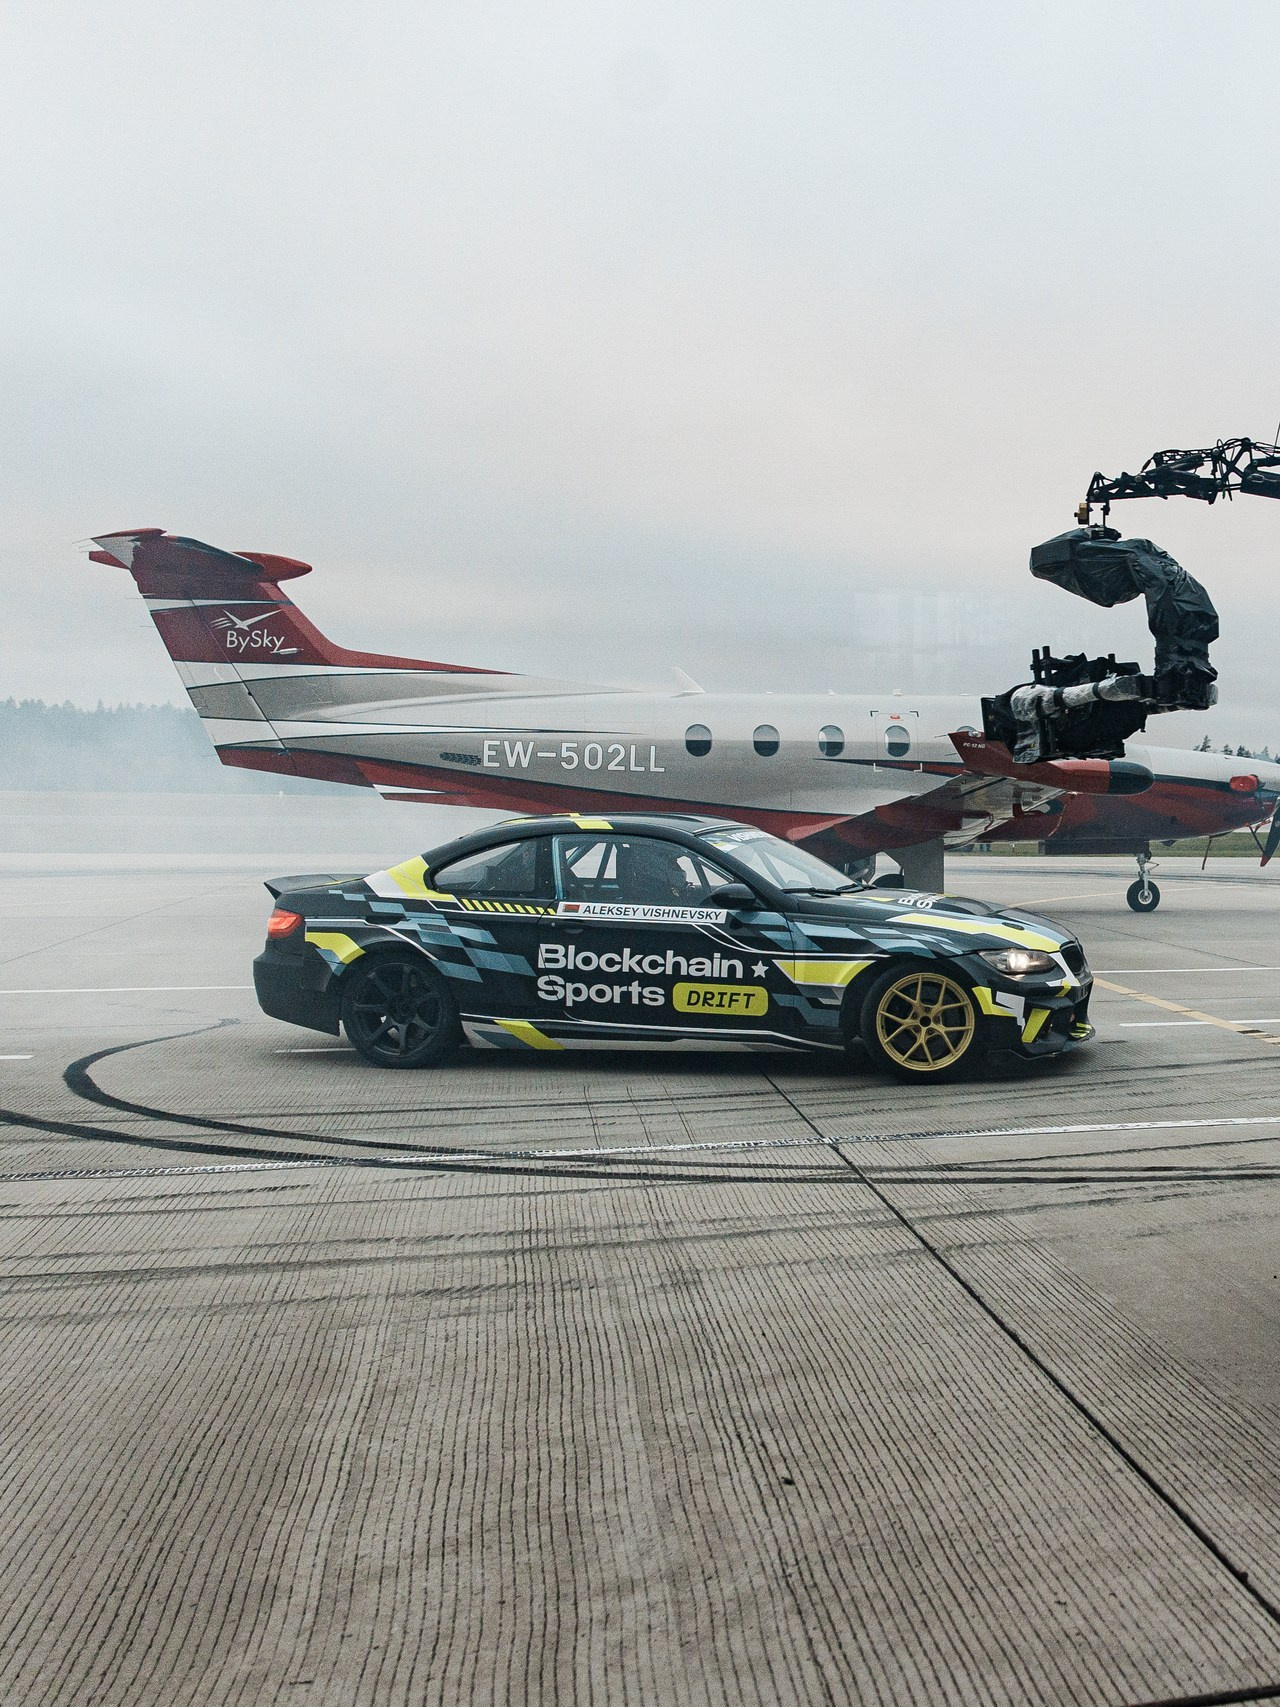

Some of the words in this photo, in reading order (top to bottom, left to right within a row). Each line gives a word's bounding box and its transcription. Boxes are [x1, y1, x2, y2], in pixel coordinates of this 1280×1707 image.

[226, 629, 285, 653] BySky
[483, 740, 665, 772] EW-502LL
[583, 905, 640, 917] ALEKSEY
[642, 907, 722, 920] VISHNEVSKY
[538, 943, 744, 978] Blockchain
[537, 975, 665, 1006] Sports
[687, 990, 755, 1009] DRIFT
